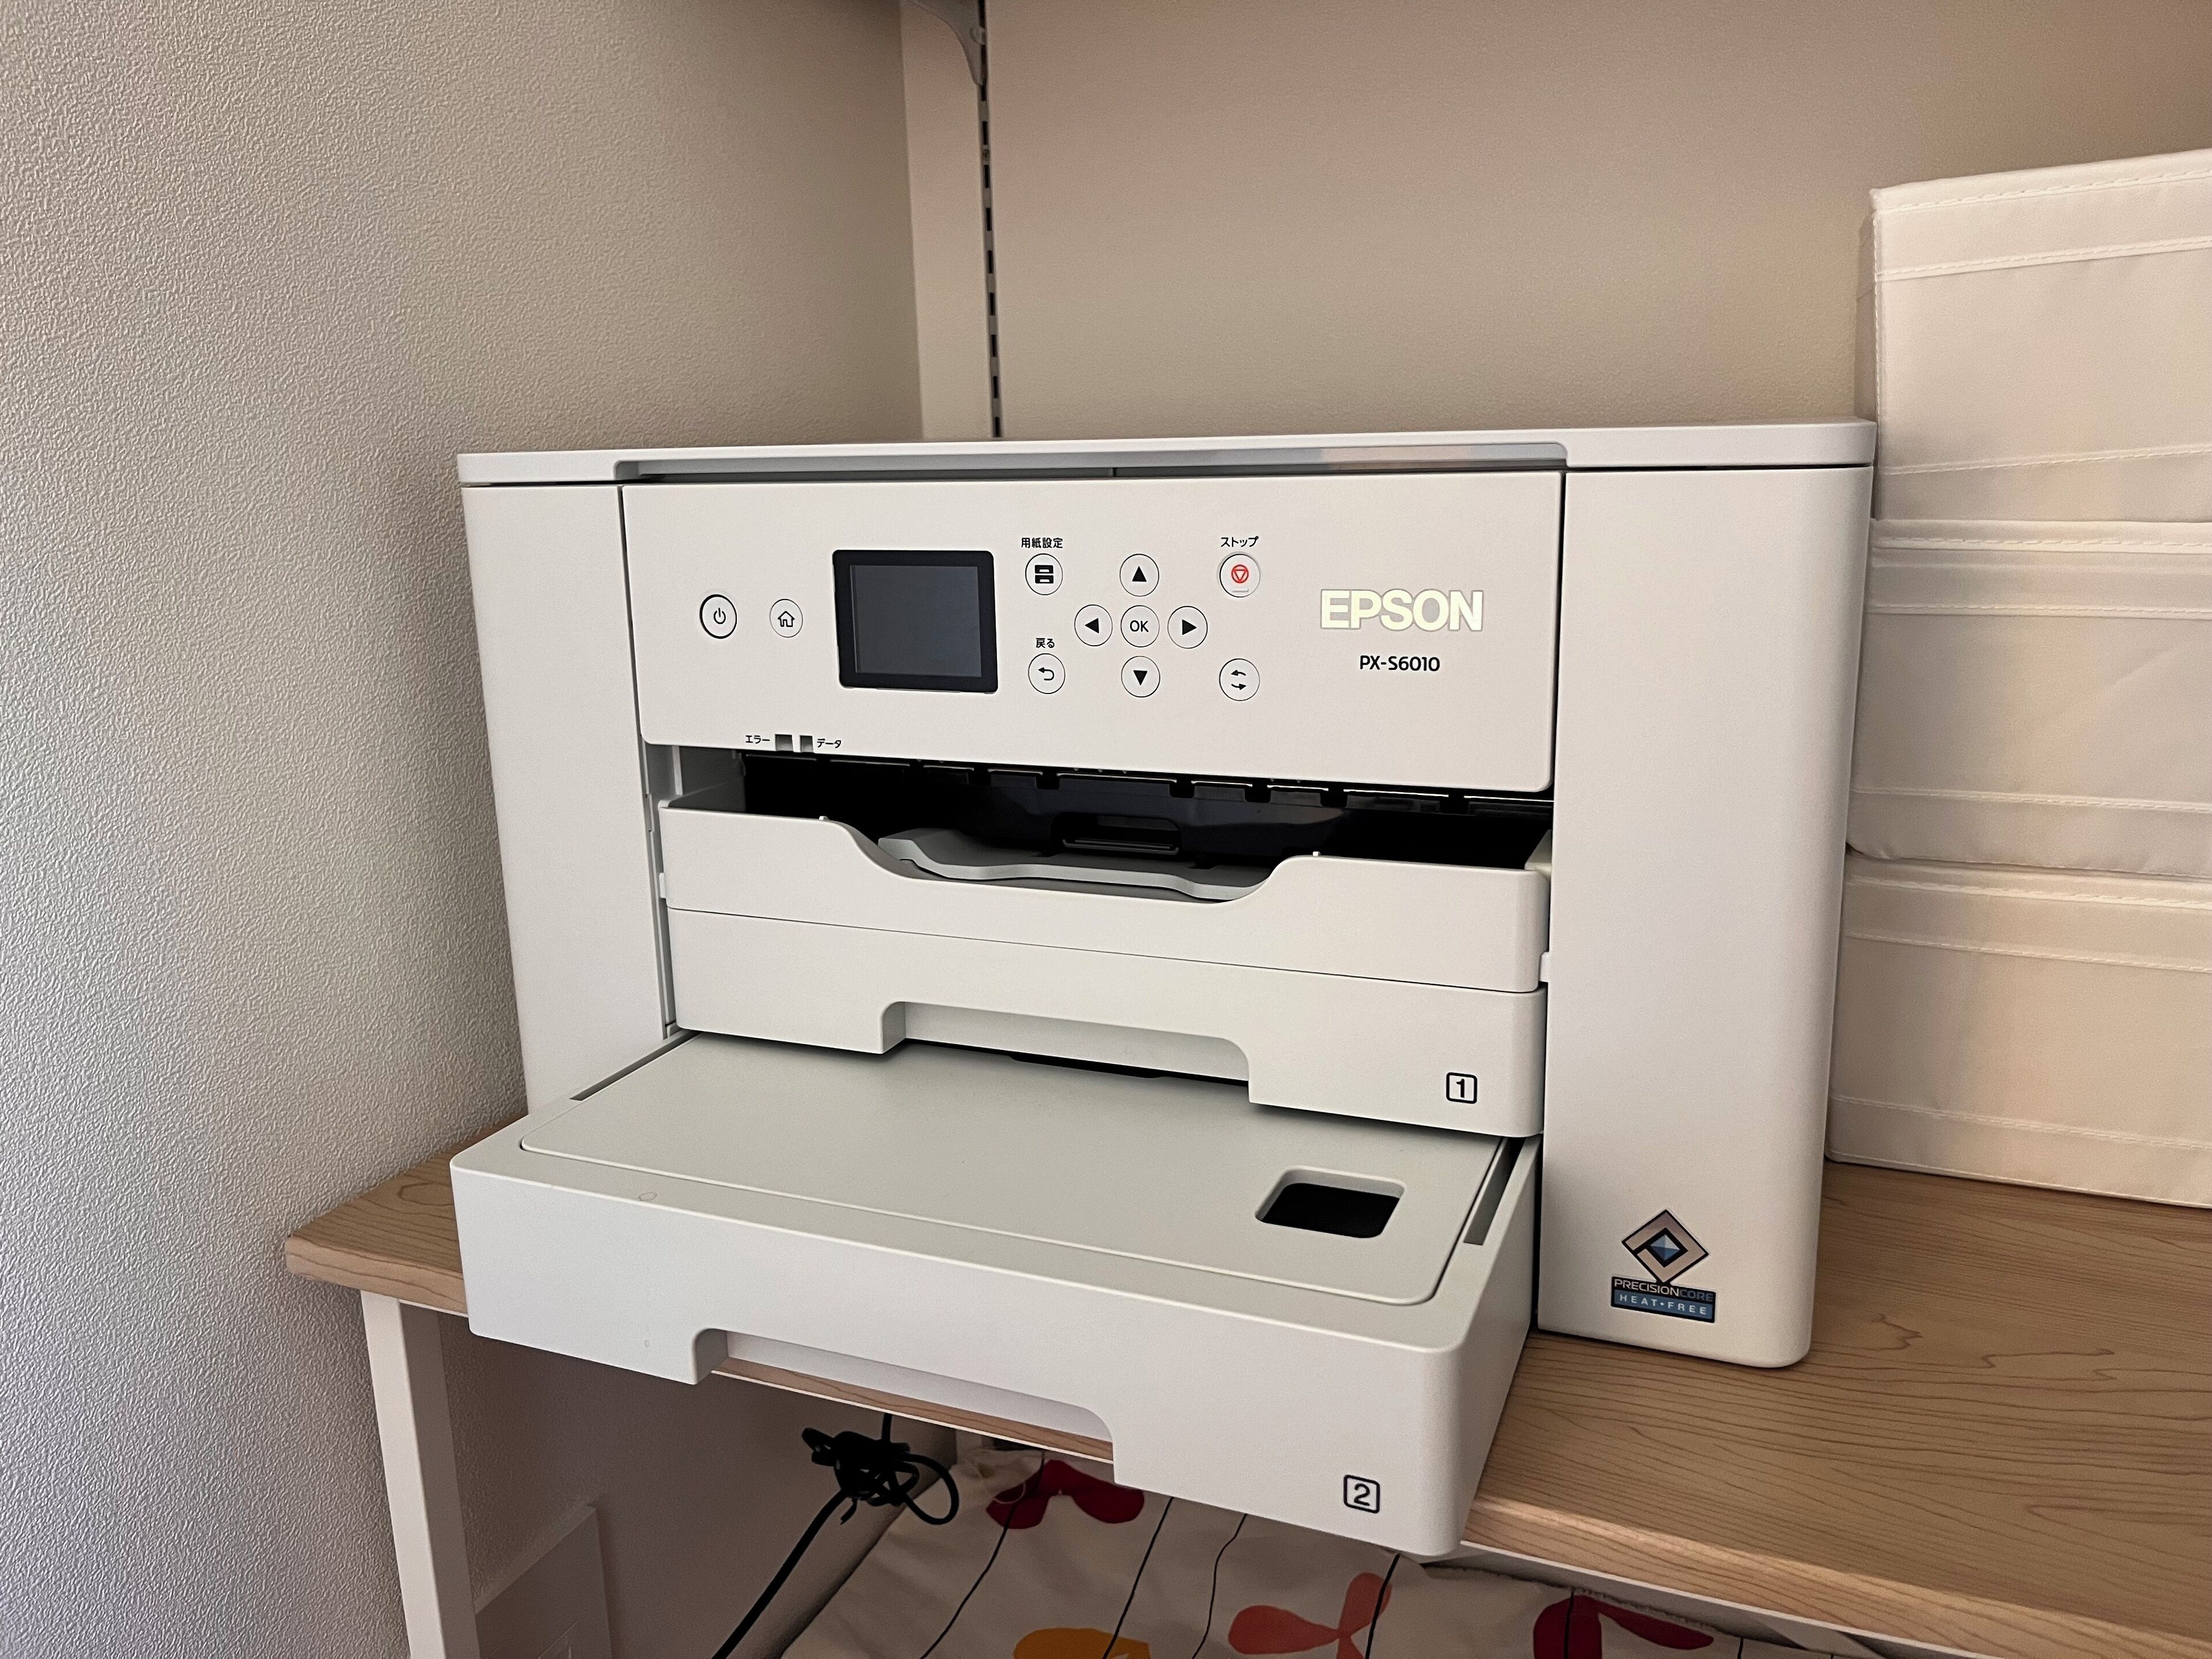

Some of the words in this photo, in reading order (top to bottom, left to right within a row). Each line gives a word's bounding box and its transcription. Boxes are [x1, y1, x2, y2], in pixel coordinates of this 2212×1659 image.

[1021, 537, 1063, 549] 用紙設定
[1220, 535, 1259, 548] ストップ
[1320, 588, 1484, 632] EPSON
[1130, 620, 1149, 633] OK
[1035, 637, 1055, 649] 戻る
[1359, 655, 1441, 672] PX-S6010
[745, 734, 771, 744] エラー
[817, 738, 842, 749] データ
[1456, 1078, 1465, 1099] 1
[1353, 1483, 1370, 1506] 2
